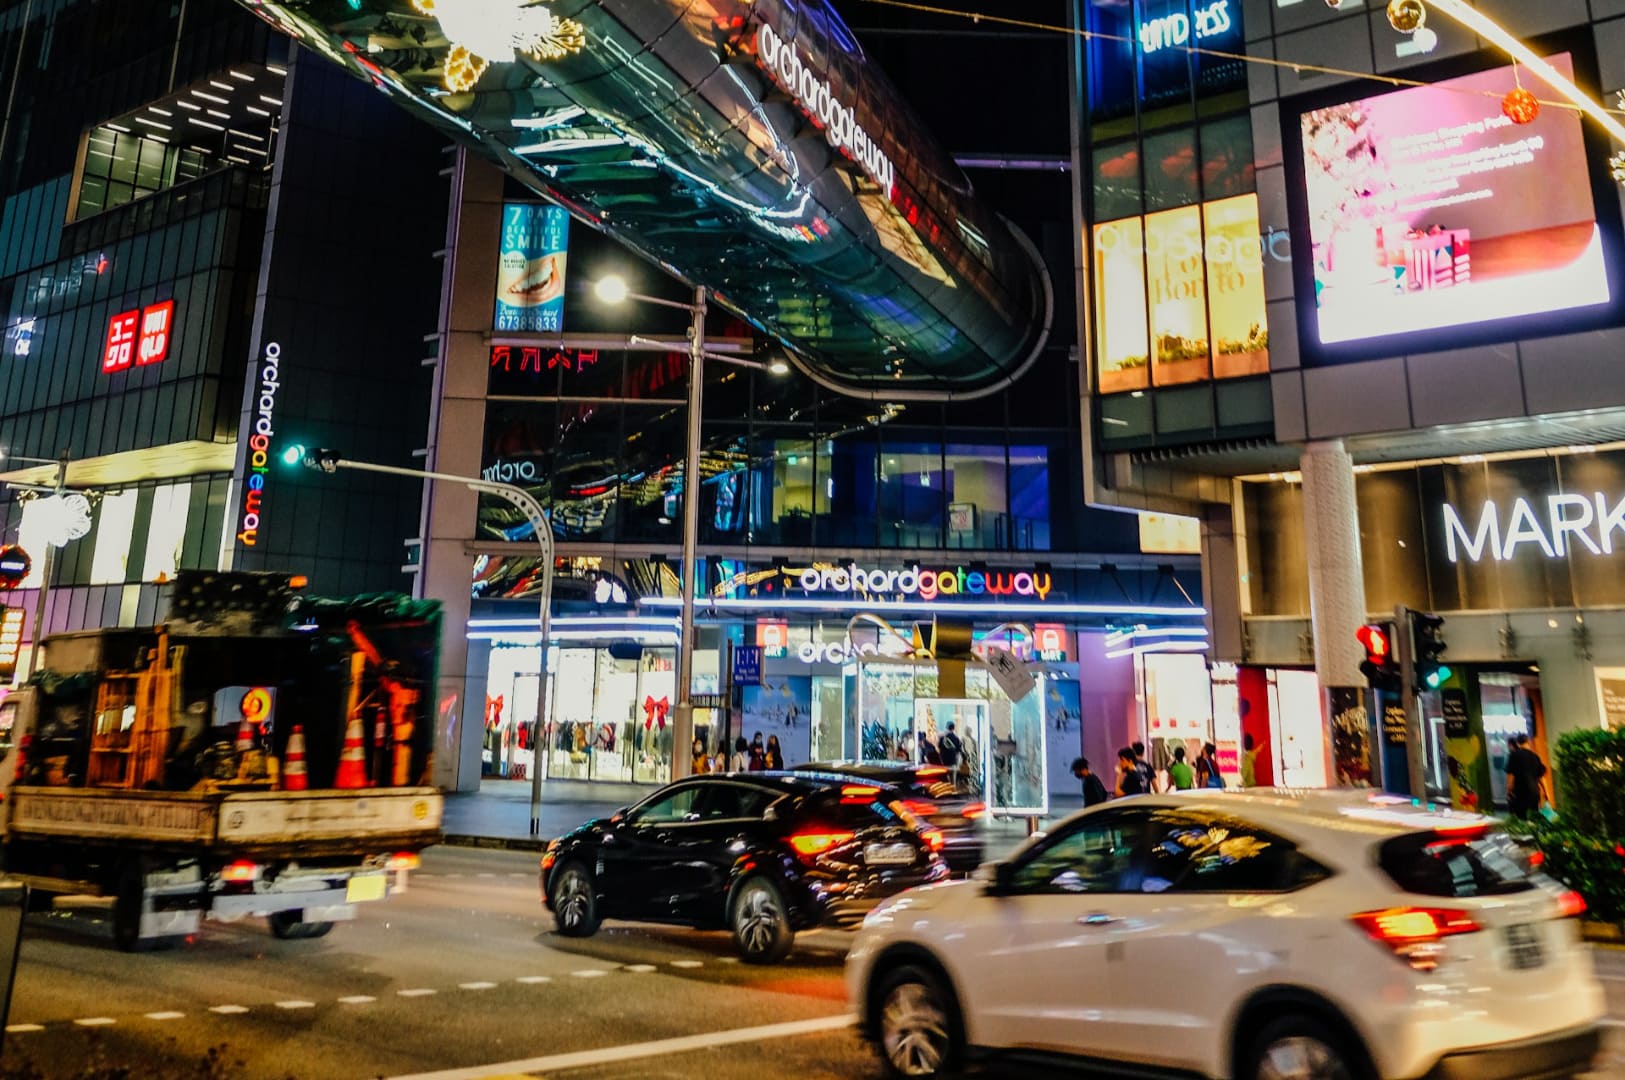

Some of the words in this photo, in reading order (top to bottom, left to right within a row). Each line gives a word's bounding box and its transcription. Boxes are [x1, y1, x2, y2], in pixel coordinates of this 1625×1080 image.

[758, 23, 894, 200] orchardgateway
[509, 207, 522, 225] 7
[527, 207, 562, 219] DAYS
[505, 234, 560, 250] SMILE
[143, 309, 168, 336] UNI
[498, 316, 558, 330] 67385833
[238, 342, 281, 546] orchardgateway
[800, 563, 1052, 600] orchardgateway
